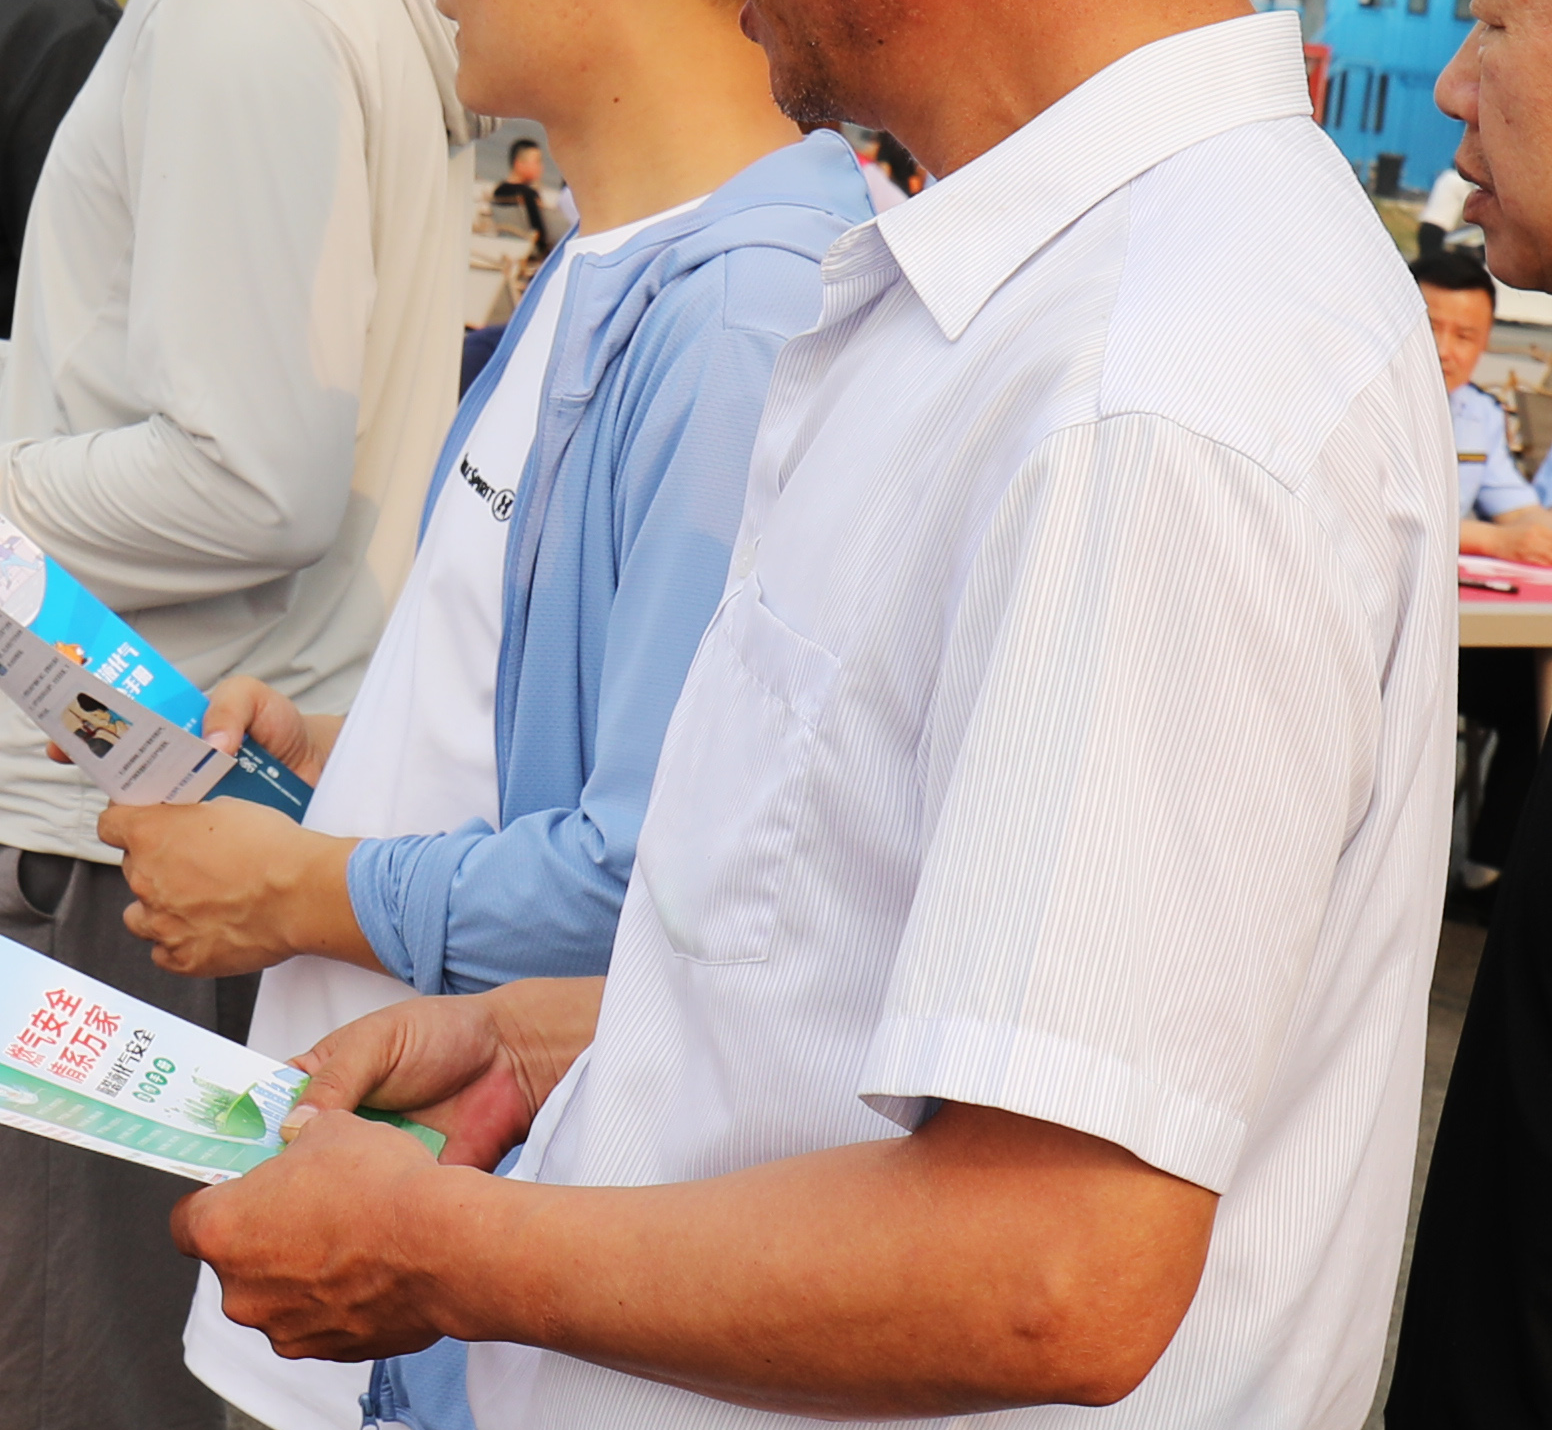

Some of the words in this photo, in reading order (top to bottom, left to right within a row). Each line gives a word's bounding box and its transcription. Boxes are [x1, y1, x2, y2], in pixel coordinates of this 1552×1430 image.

[4, 987, 84, 1068] 燃气安全
[47, 1004, 122, 1084] 情系万家
